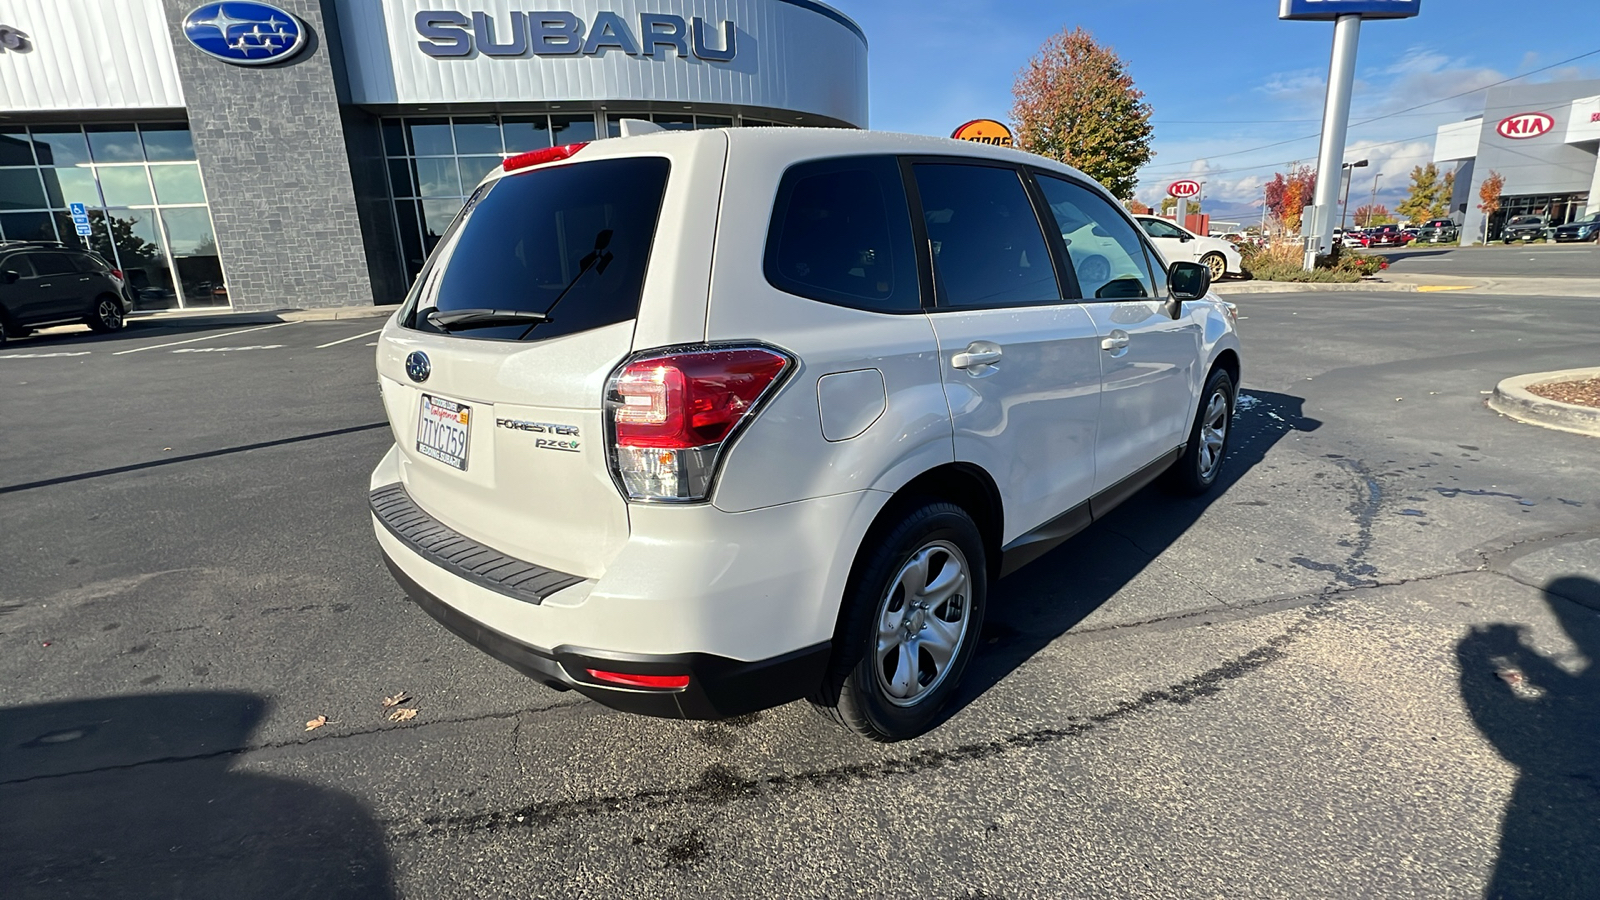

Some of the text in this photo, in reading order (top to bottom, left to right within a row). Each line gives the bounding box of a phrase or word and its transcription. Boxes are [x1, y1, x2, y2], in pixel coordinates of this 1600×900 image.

[414, 10, 737, 61] SUBARU
[1506, 117, 1544, 135] KIA
[1174, 183, 1194, 195] KIA
[496, 418, 580, 437] FORESTER
[423, 418, 465, 457] 7TYC759
